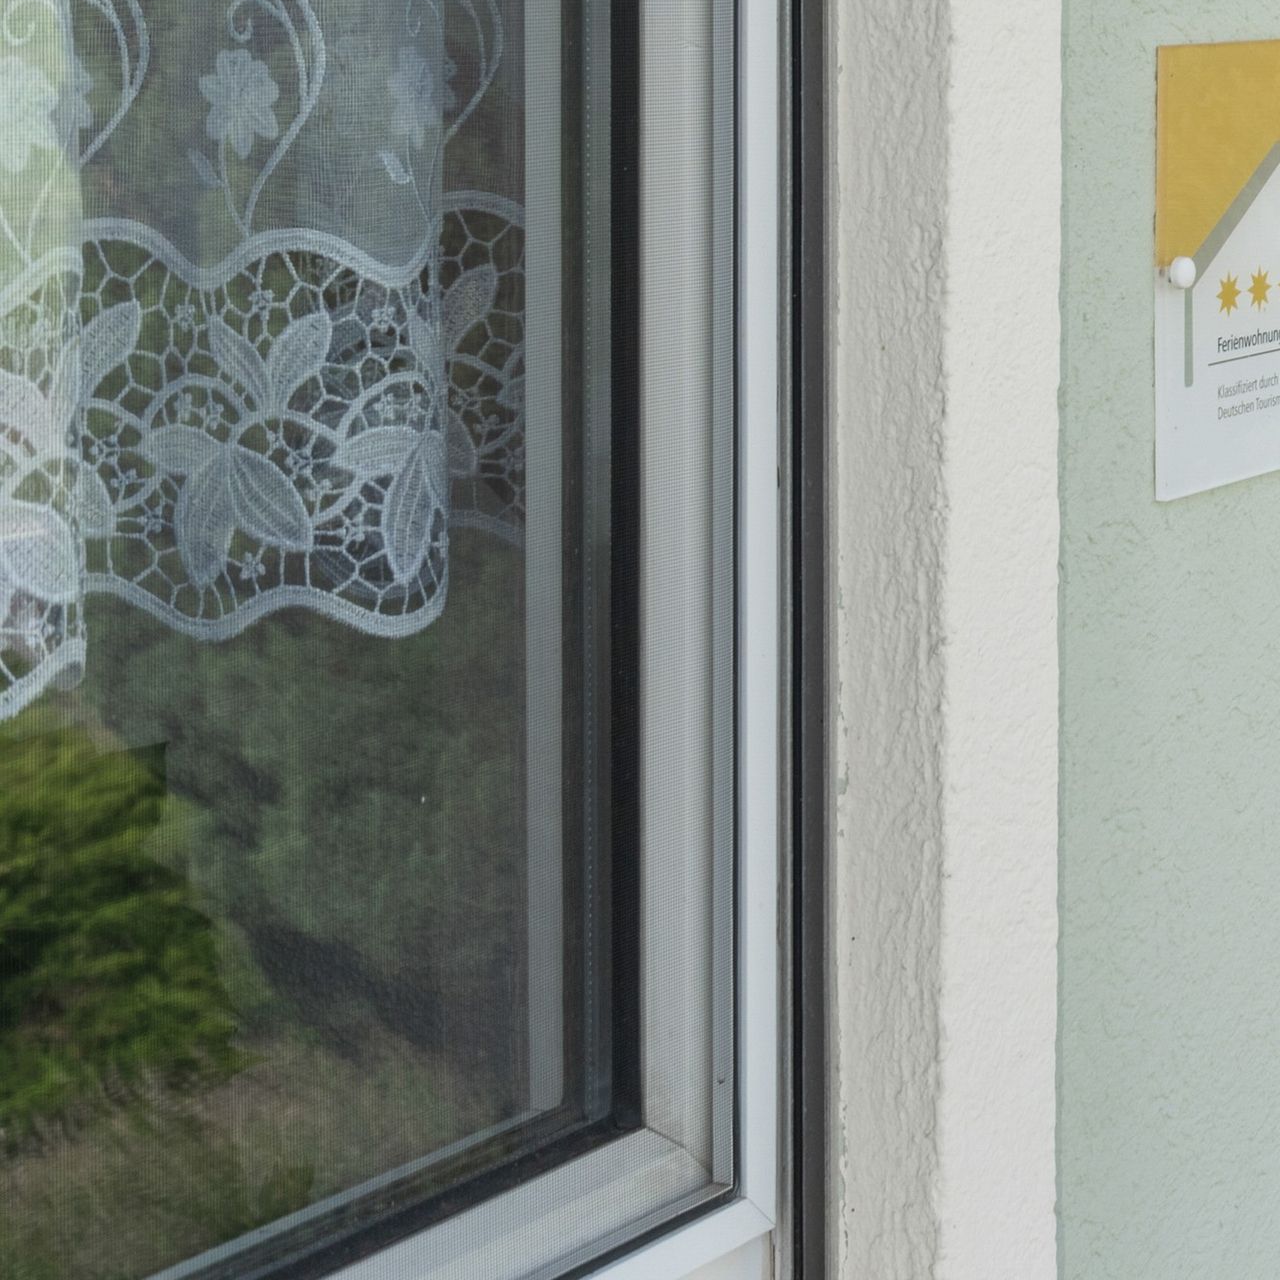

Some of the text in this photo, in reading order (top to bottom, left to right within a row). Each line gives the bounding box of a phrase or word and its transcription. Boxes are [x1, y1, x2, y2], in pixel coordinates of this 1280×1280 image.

[1217, 379, 1258, 399] Klassifiziert
[1259, 372, 1279, 389] durch
[1217, 401, 1255, 420] Deutschen
